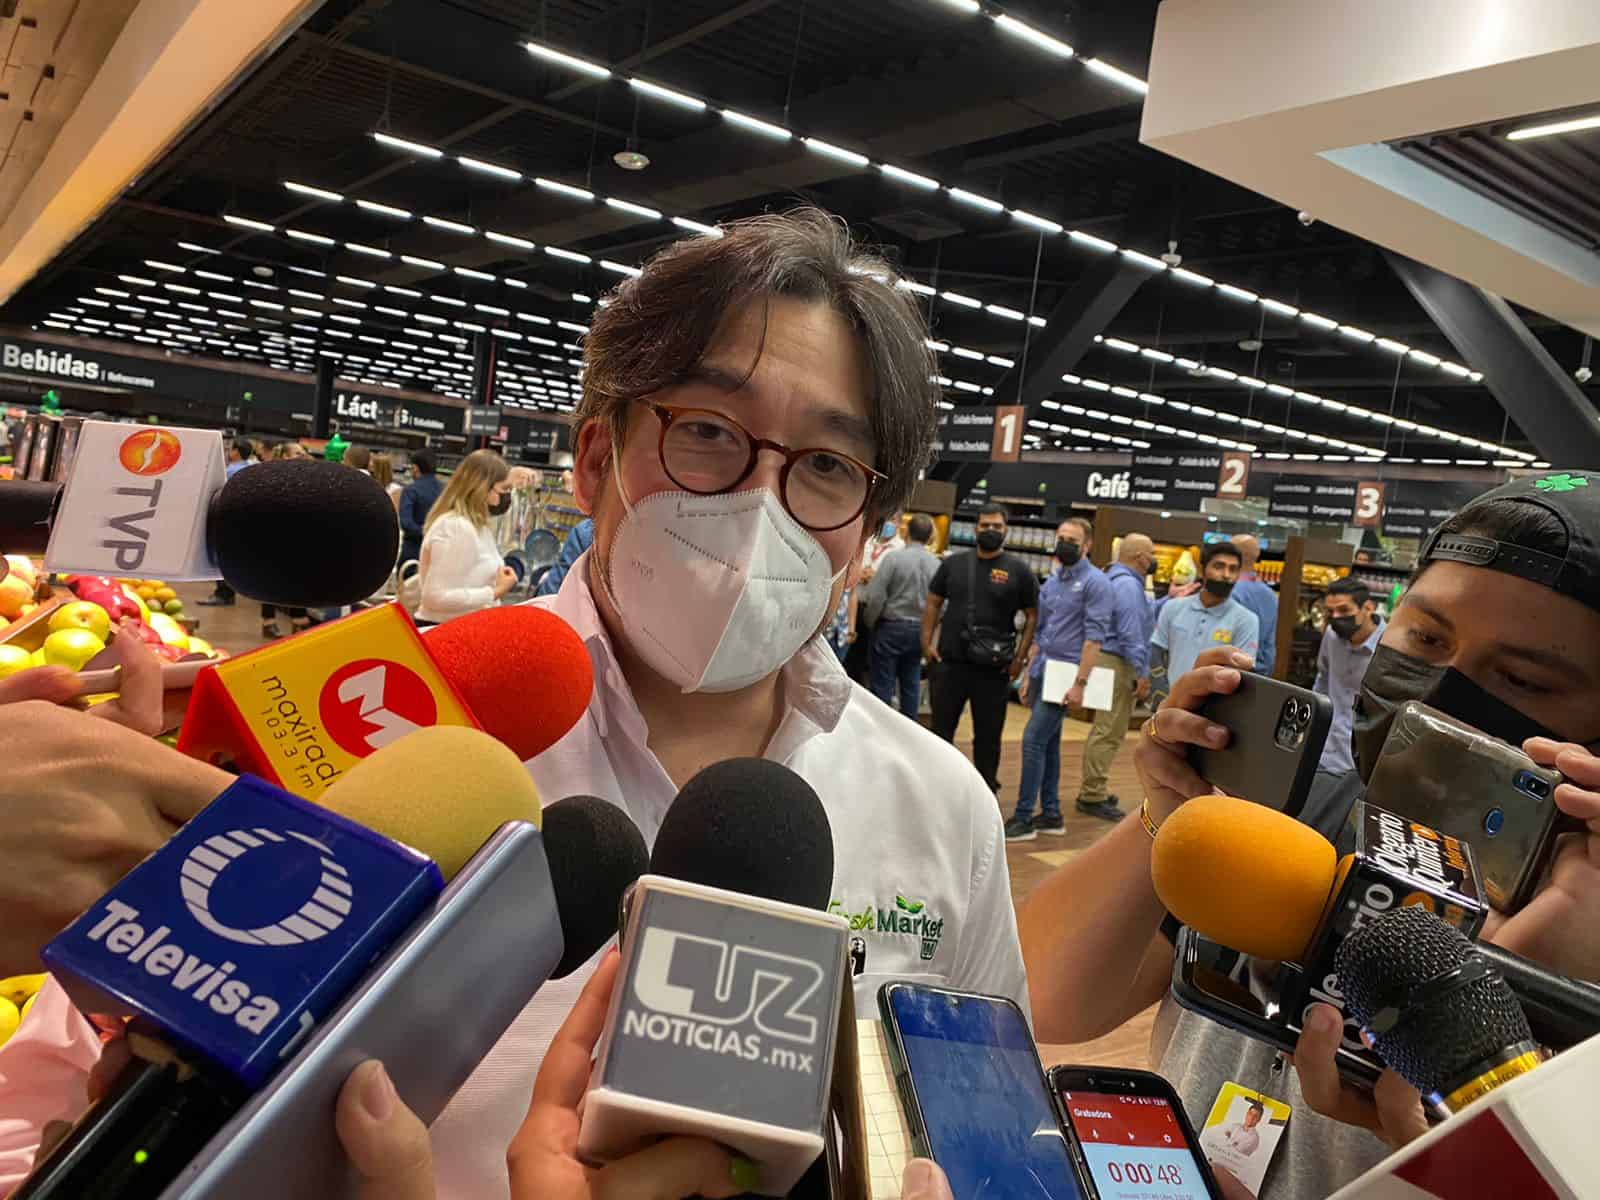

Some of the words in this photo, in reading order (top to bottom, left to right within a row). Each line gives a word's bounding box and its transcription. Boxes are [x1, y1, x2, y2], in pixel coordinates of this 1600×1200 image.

[3, 344, 99, 379] Bebidas
[1000, 414, 1016, 453] 1
[1087, 471, 1130, 499] Café
[1220, 459, 1245, 493] 2
[1357, 487, 1380, 518] 3
[102, 478, 163, 570] TVP
[261, 675, 343, 787] maxirad
[876, 908, 944, 938] Market
[87, 899, 281, 1035] Televisa
[634, 926, 825, 1044] LUZ
[623, 1009, 814, 1074] NOTICIAS.mx
